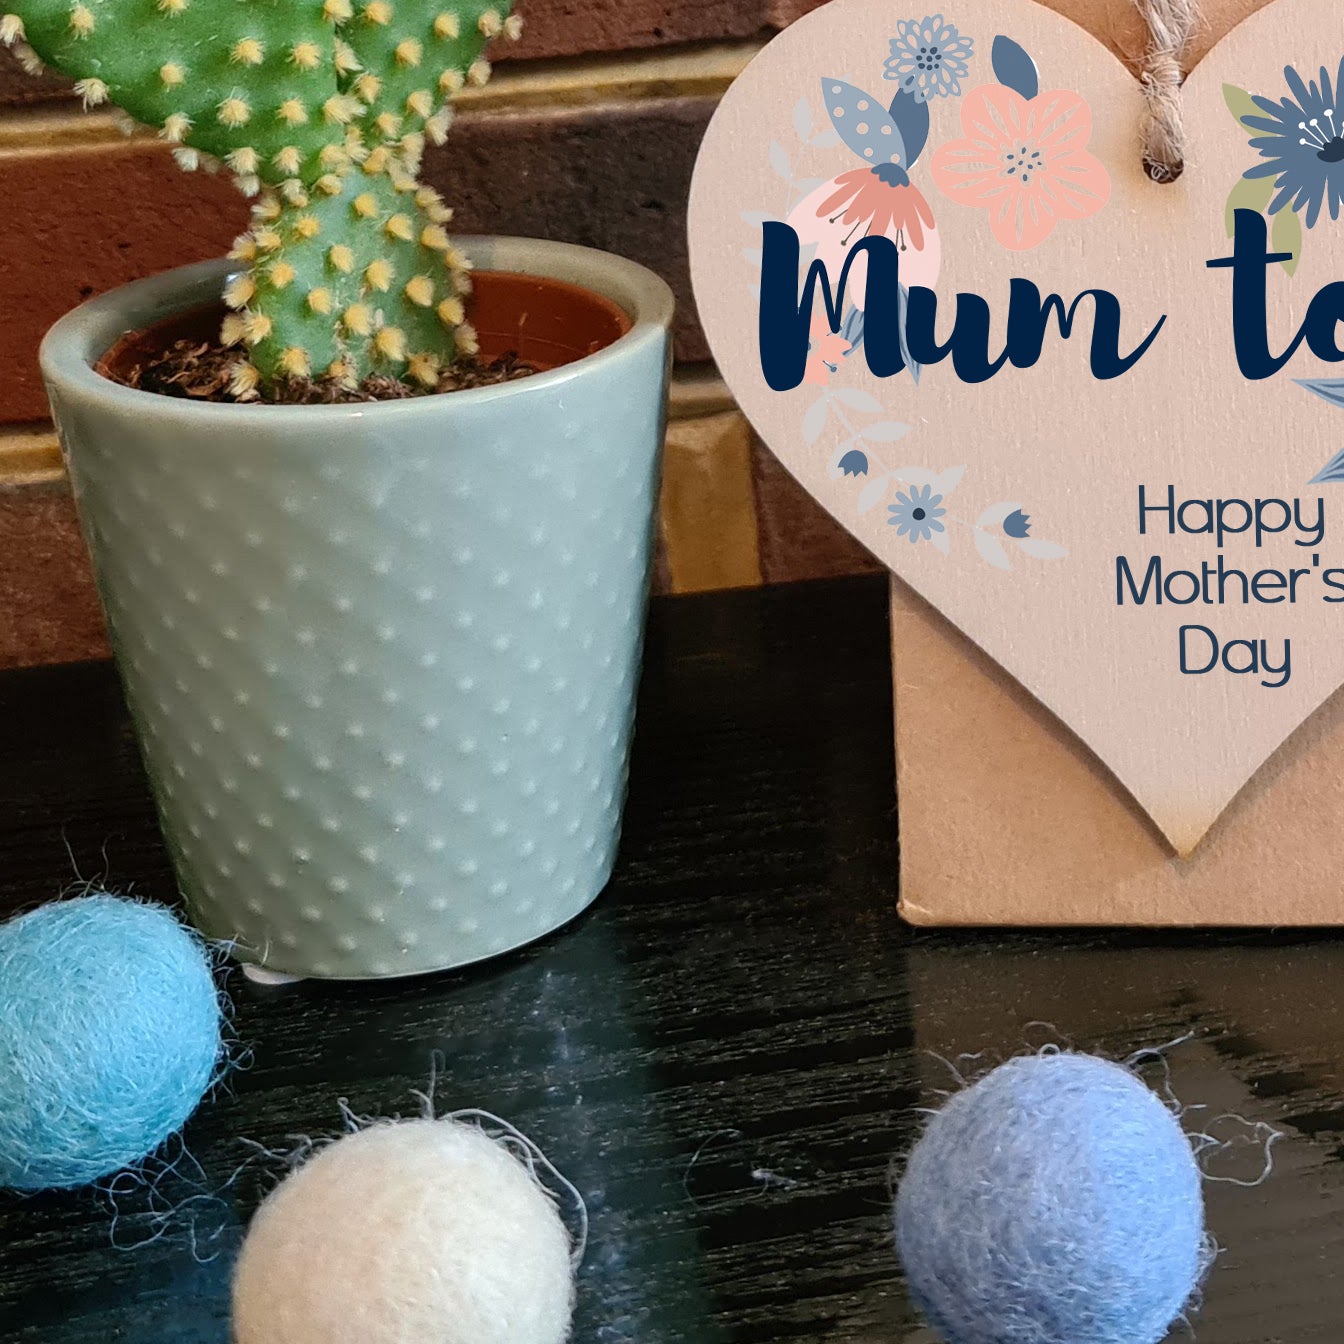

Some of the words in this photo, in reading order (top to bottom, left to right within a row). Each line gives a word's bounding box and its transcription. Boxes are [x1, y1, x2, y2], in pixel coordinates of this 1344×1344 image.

[759, 221, 1168, 392] Mum
[1137, 484, 1326, 548] Happy
[1177, 624, 1292, 688] Day
